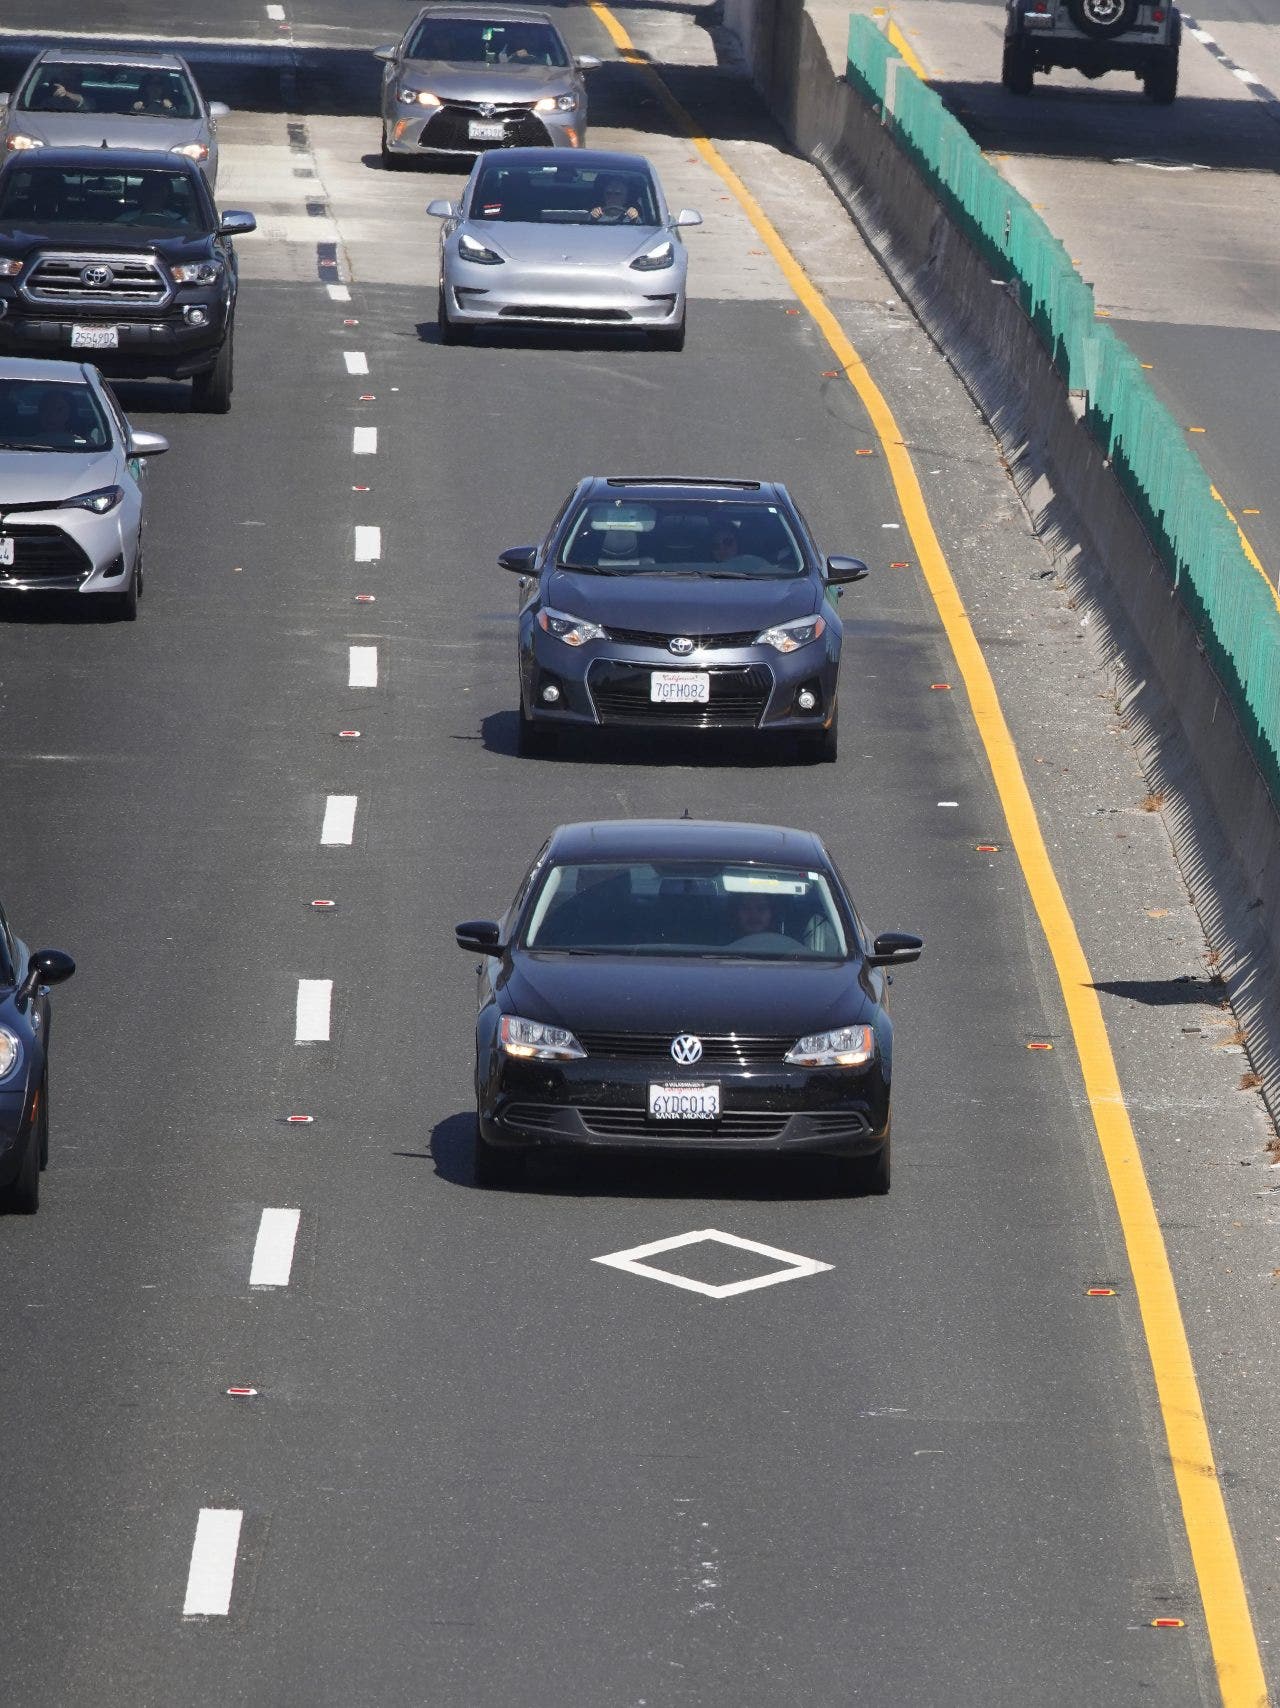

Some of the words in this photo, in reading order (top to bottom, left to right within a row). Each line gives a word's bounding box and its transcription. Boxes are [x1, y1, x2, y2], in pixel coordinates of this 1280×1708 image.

[656, 682, 705, 698] 7GFH082
[653, 1095, 716, 1114] 6YDC013
[655, 1112, 680, 1120] SANTA
[682, 1112, 715, 1120] MONICA
